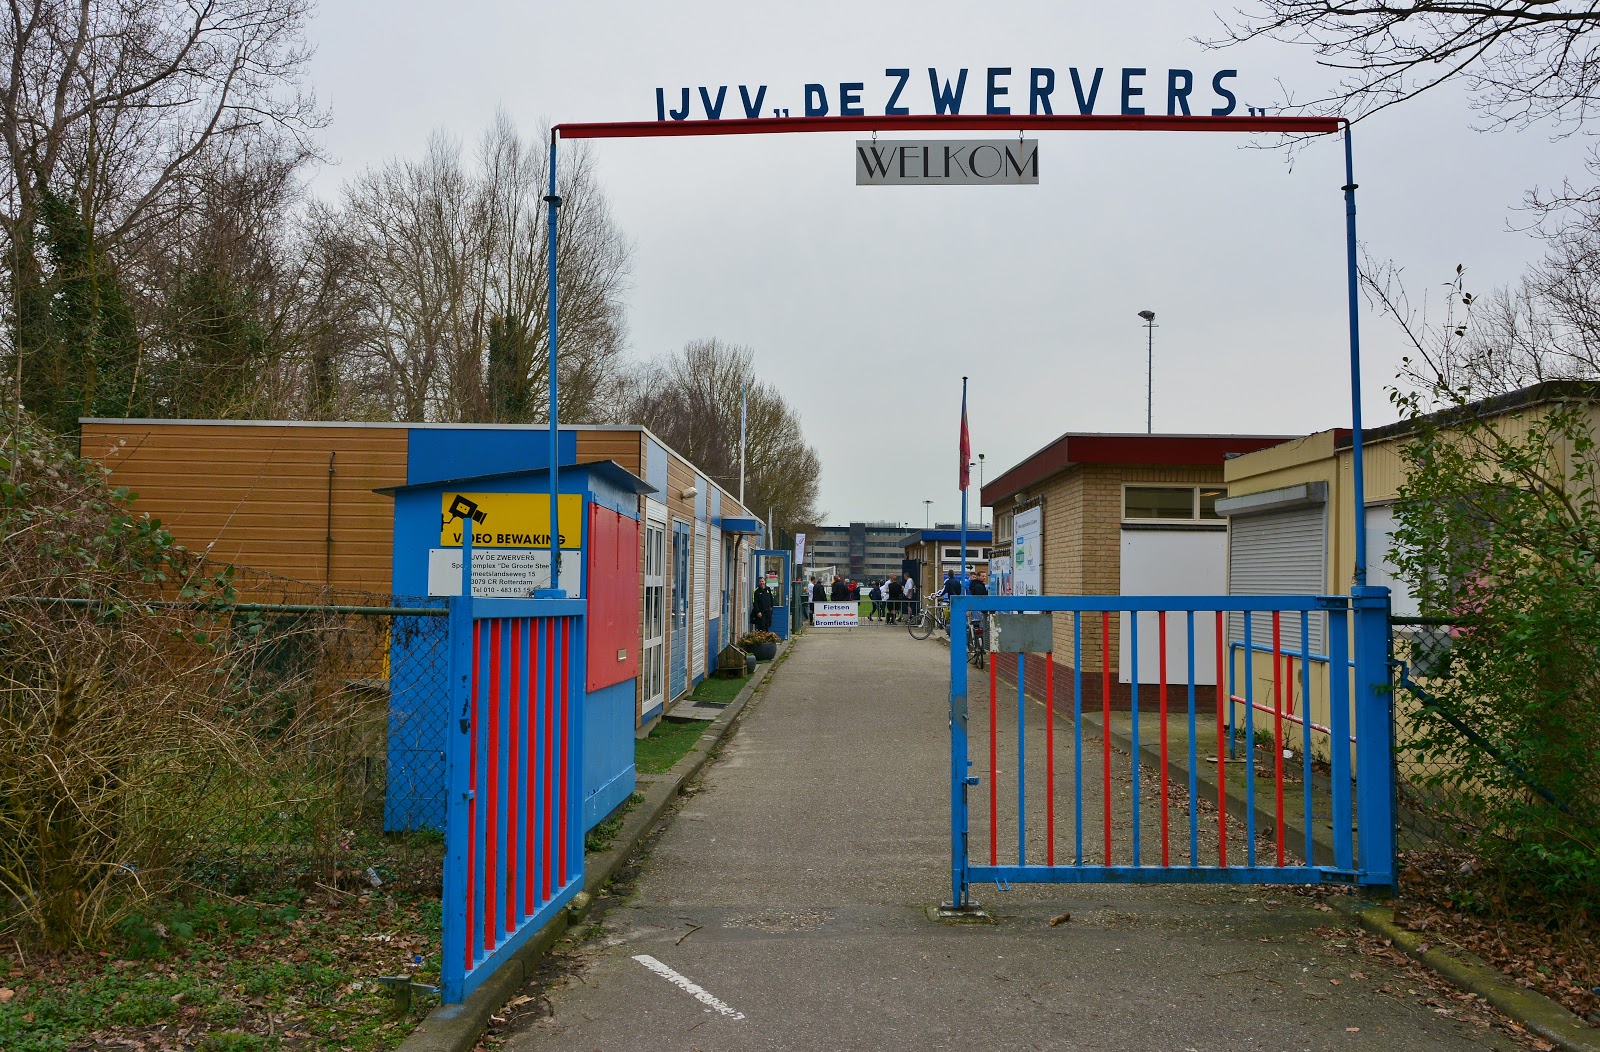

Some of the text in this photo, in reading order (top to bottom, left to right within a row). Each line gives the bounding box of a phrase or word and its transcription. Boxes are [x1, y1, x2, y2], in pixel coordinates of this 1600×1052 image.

[655, 85, 768, 122] IJVV
[857, 145, 1038, 179] WELKOM
[453, 533, 493, 544] VEO
[451, 562, 496, 570] Spoomplex
